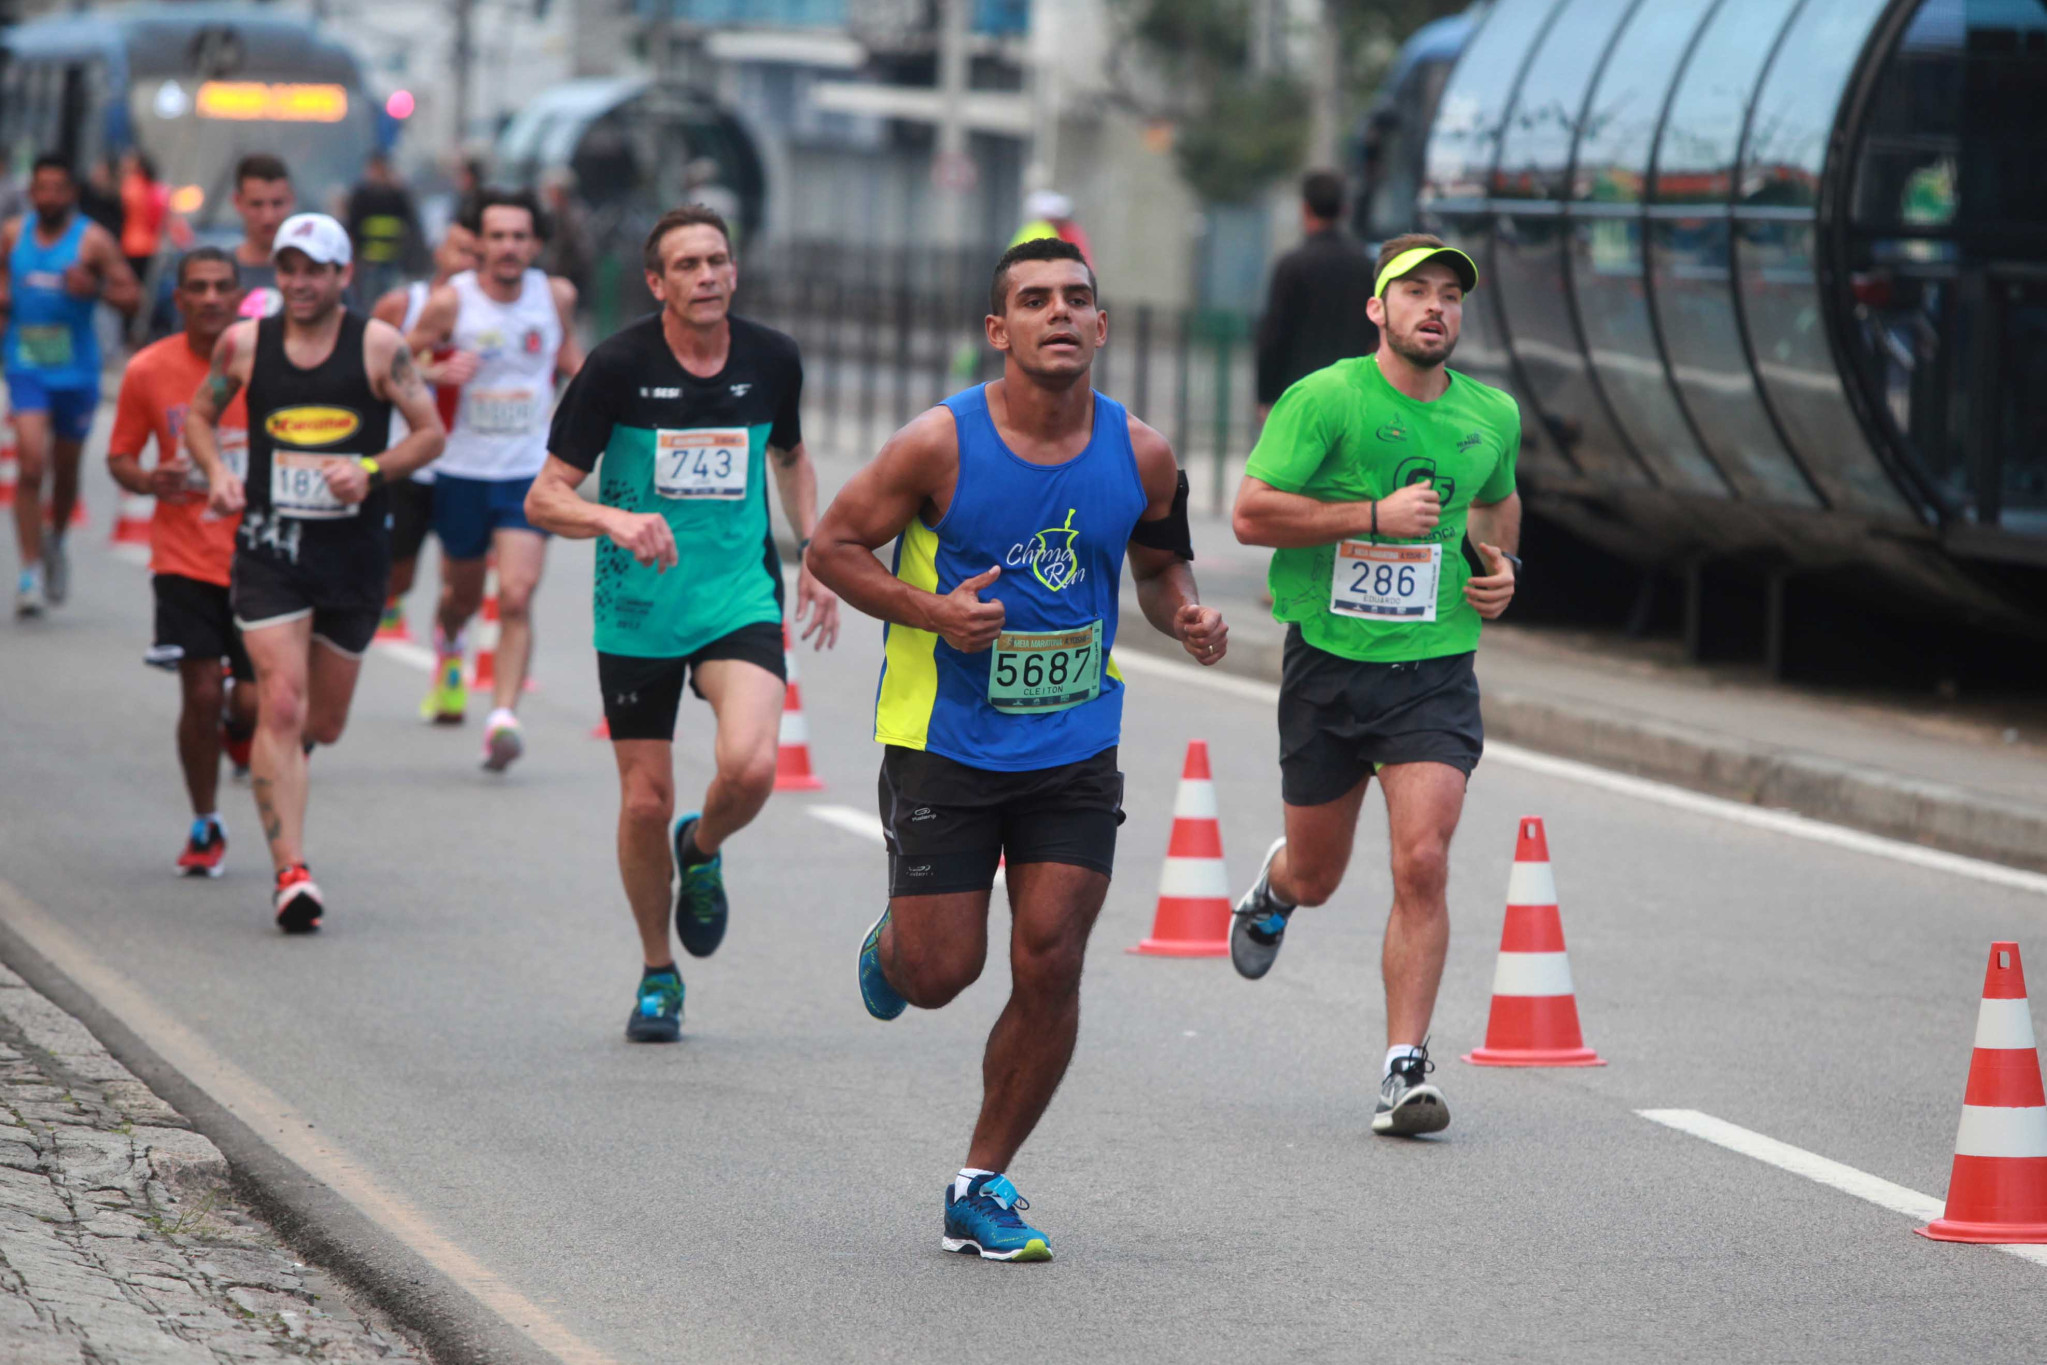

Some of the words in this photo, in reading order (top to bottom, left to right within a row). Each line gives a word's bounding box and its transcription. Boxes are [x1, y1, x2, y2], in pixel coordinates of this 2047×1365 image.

[671, 448, 732, 479] 743
[281, 469, 326, 498] 187
[1006, 538, 1075, 565] Chima
[1044, 562, 1086, 589] Run
[1349, 561, 1416, 597] 286
[1363, 595, 1402, 605] EDUARDO
[996, 646, 1091, 687] 5687
[1023, 686, 1064, 696] CLEITON
